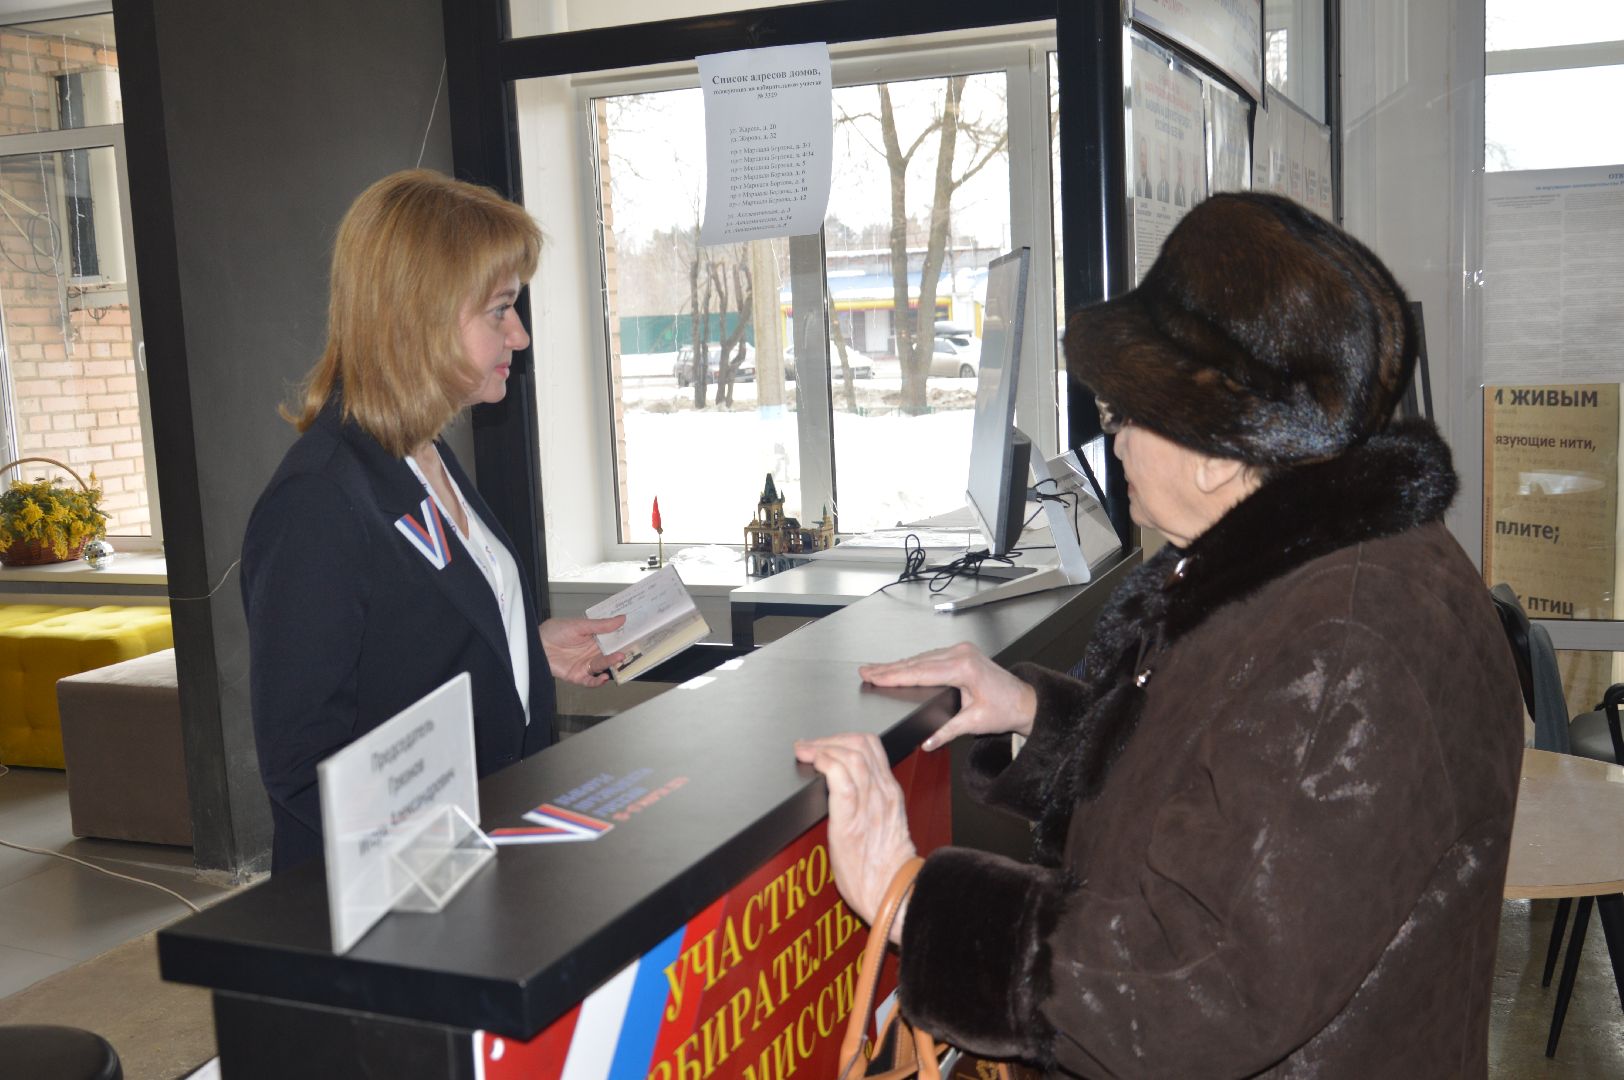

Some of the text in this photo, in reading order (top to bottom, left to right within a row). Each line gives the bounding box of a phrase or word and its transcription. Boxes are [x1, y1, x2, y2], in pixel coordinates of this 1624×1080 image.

[712, 68, 821, 85] Список адресов домов,
[1510, 389, 1598, 408] ЖИВЫМ
[1495, 435, 1597, 453] язующие нити,
[1495, 520, 1561, 545] плите;
[1528, 596, 1575, 619] птиц
[663, 843, 835, 1023] УЧАСТКО
[647, 898, 863, 1080] БИРАТЕЛЬ
[742, 950, 866, 1080] ИССИ
